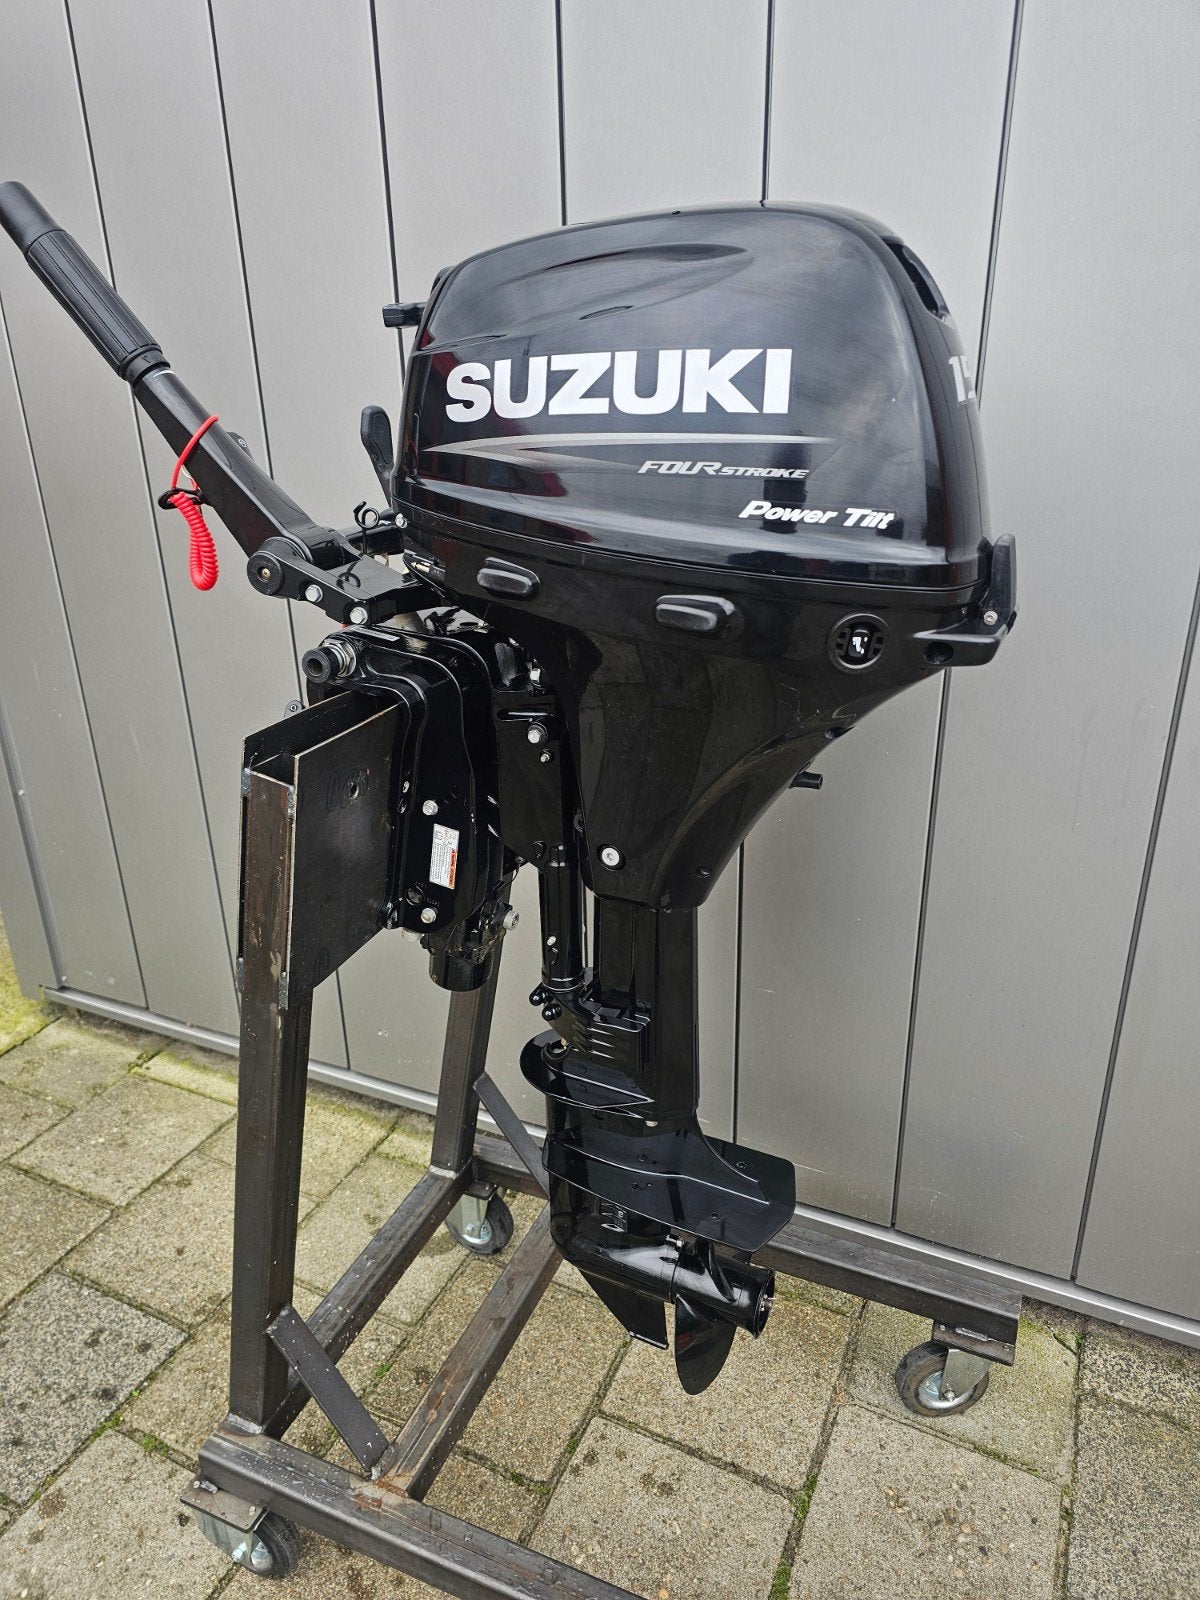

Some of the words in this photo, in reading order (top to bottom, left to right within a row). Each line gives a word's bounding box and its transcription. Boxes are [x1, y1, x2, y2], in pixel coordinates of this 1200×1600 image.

[445, 348, 793, 423] SUZUKI
[637, 460, 722, 476] FOUR
[718, 466, 809, 479] STROKE
[738, 500, 838, 524] Power
[843, 507, 895, 530] Tilt
